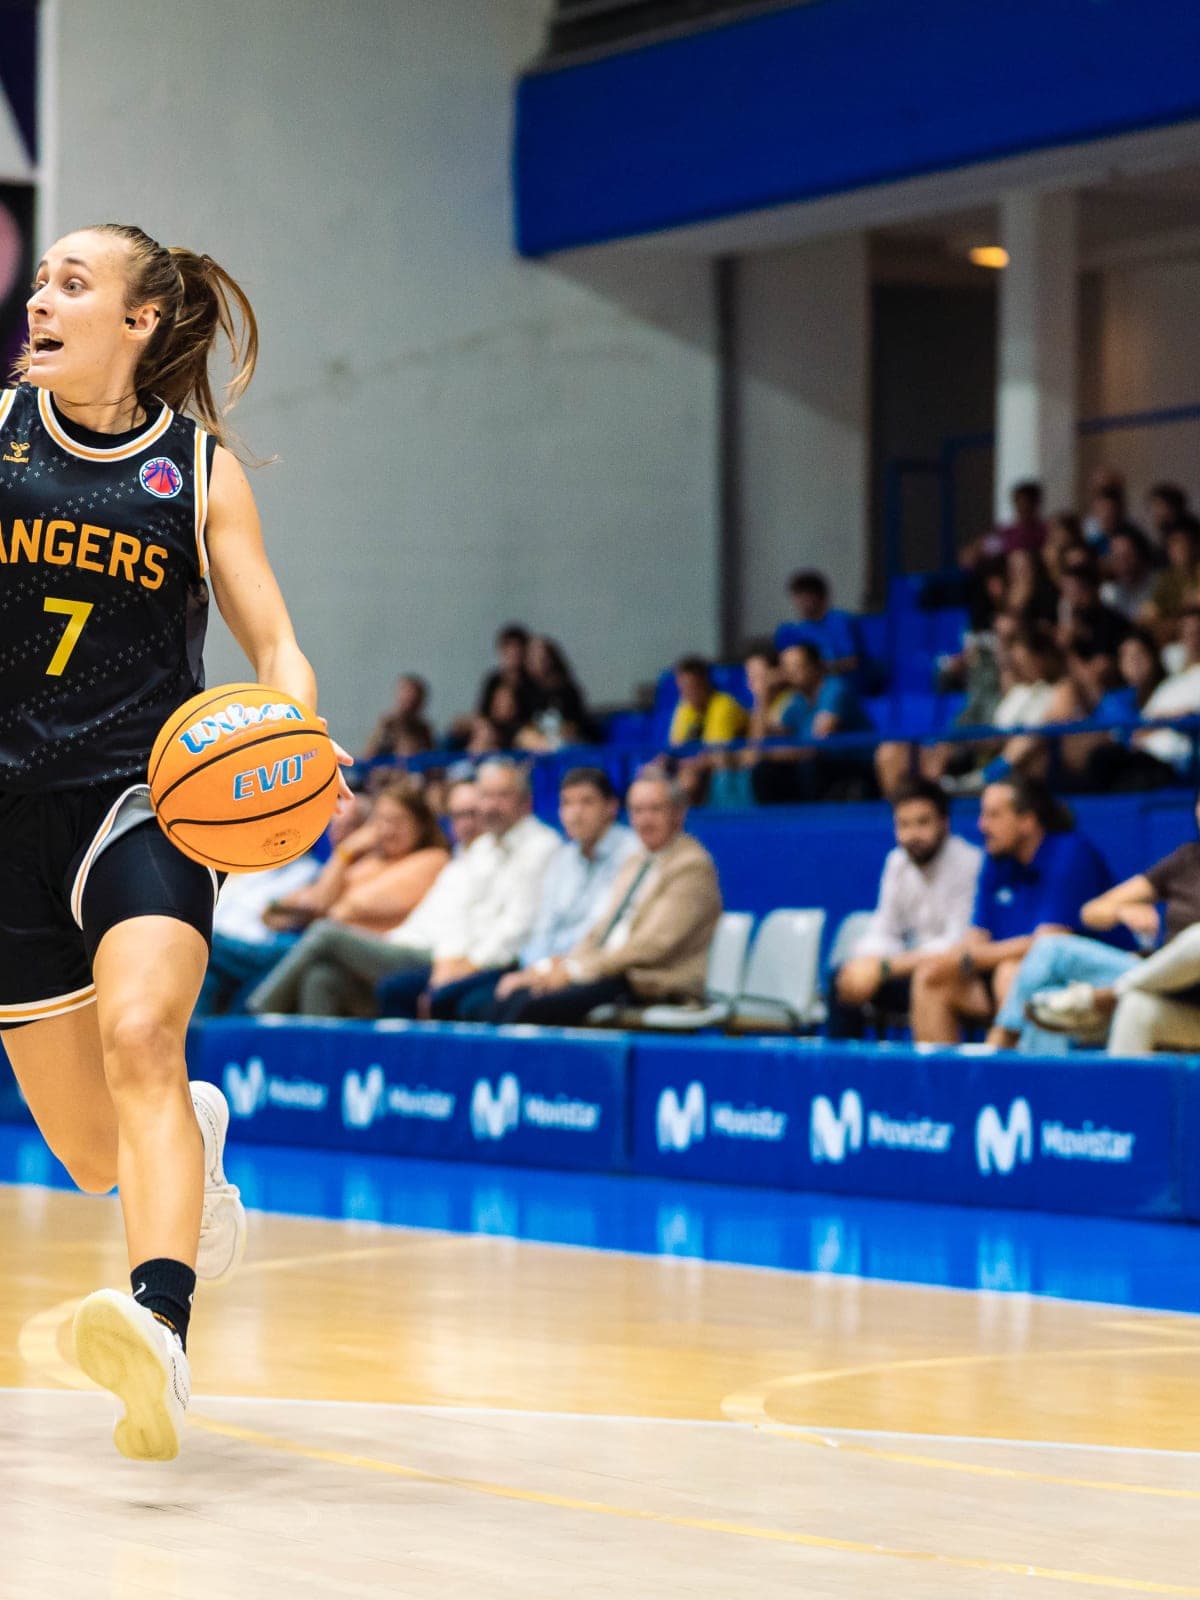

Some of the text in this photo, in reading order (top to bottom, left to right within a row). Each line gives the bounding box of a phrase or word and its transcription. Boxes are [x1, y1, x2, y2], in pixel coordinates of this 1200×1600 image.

[43, 596, 94, 676] 7
[179, 703, 305, 754] Wilson
[233, 754, 302, 800] EVO
